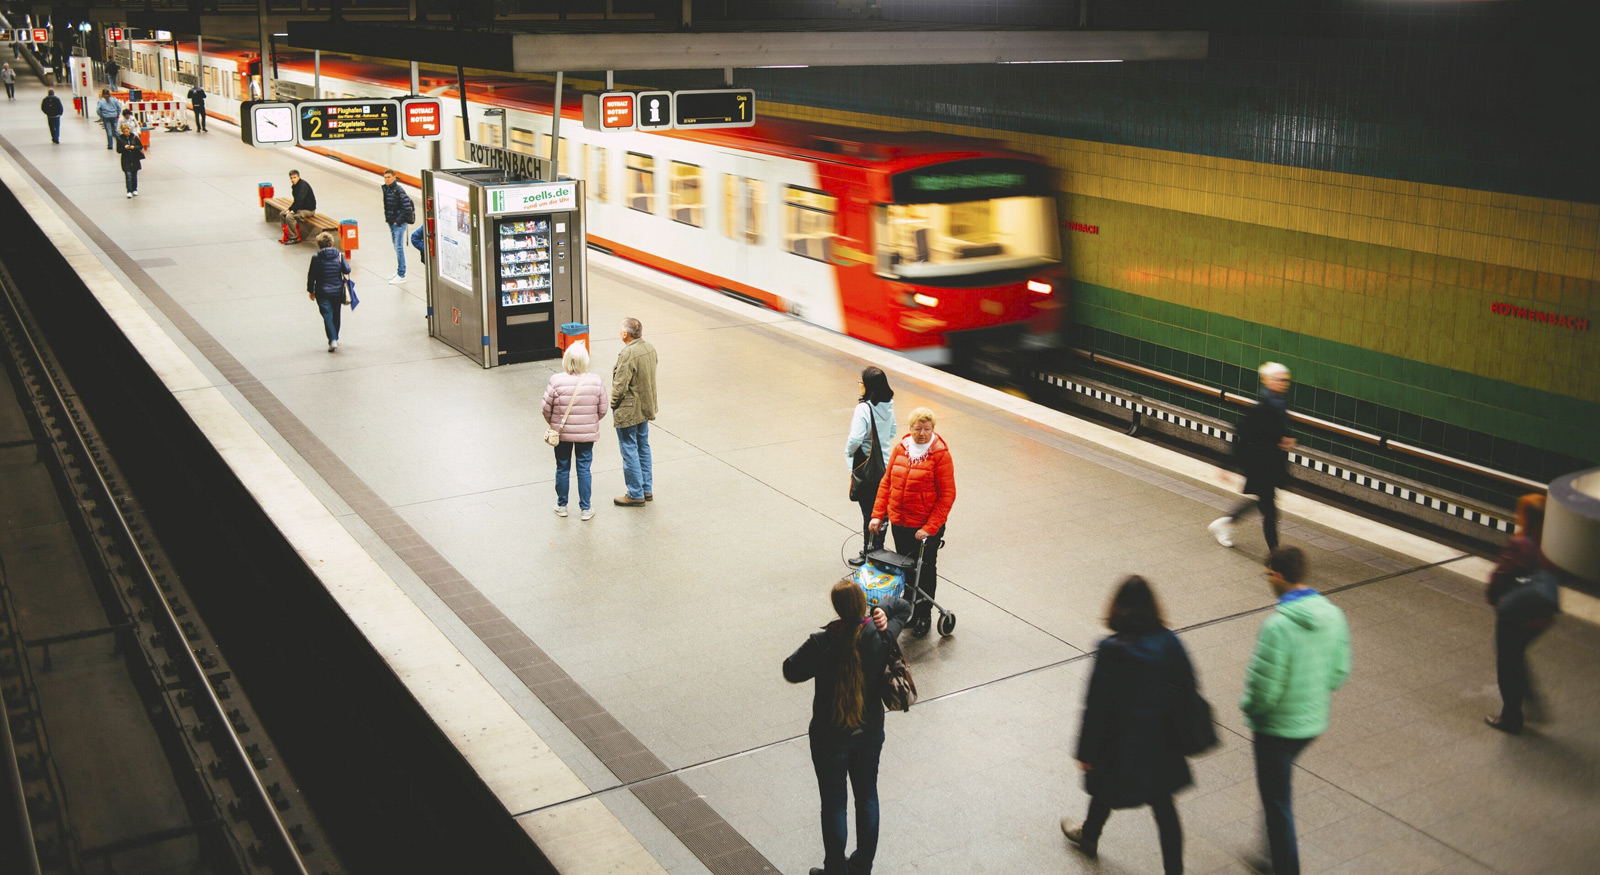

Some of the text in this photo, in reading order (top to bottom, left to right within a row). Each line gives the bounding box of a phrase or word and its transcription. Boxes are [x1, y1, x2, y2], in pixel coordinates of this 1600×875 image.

[337, 106, 362, 115] Flughafen
[738, 102, 745, 120] 1
[310, 116, 323, 138] 2
[337, 120, 366, 129] Ziegelstein
[523, 188, 569, 203] zoells.de
[1061, 221, 1098, 235] ENBACH
